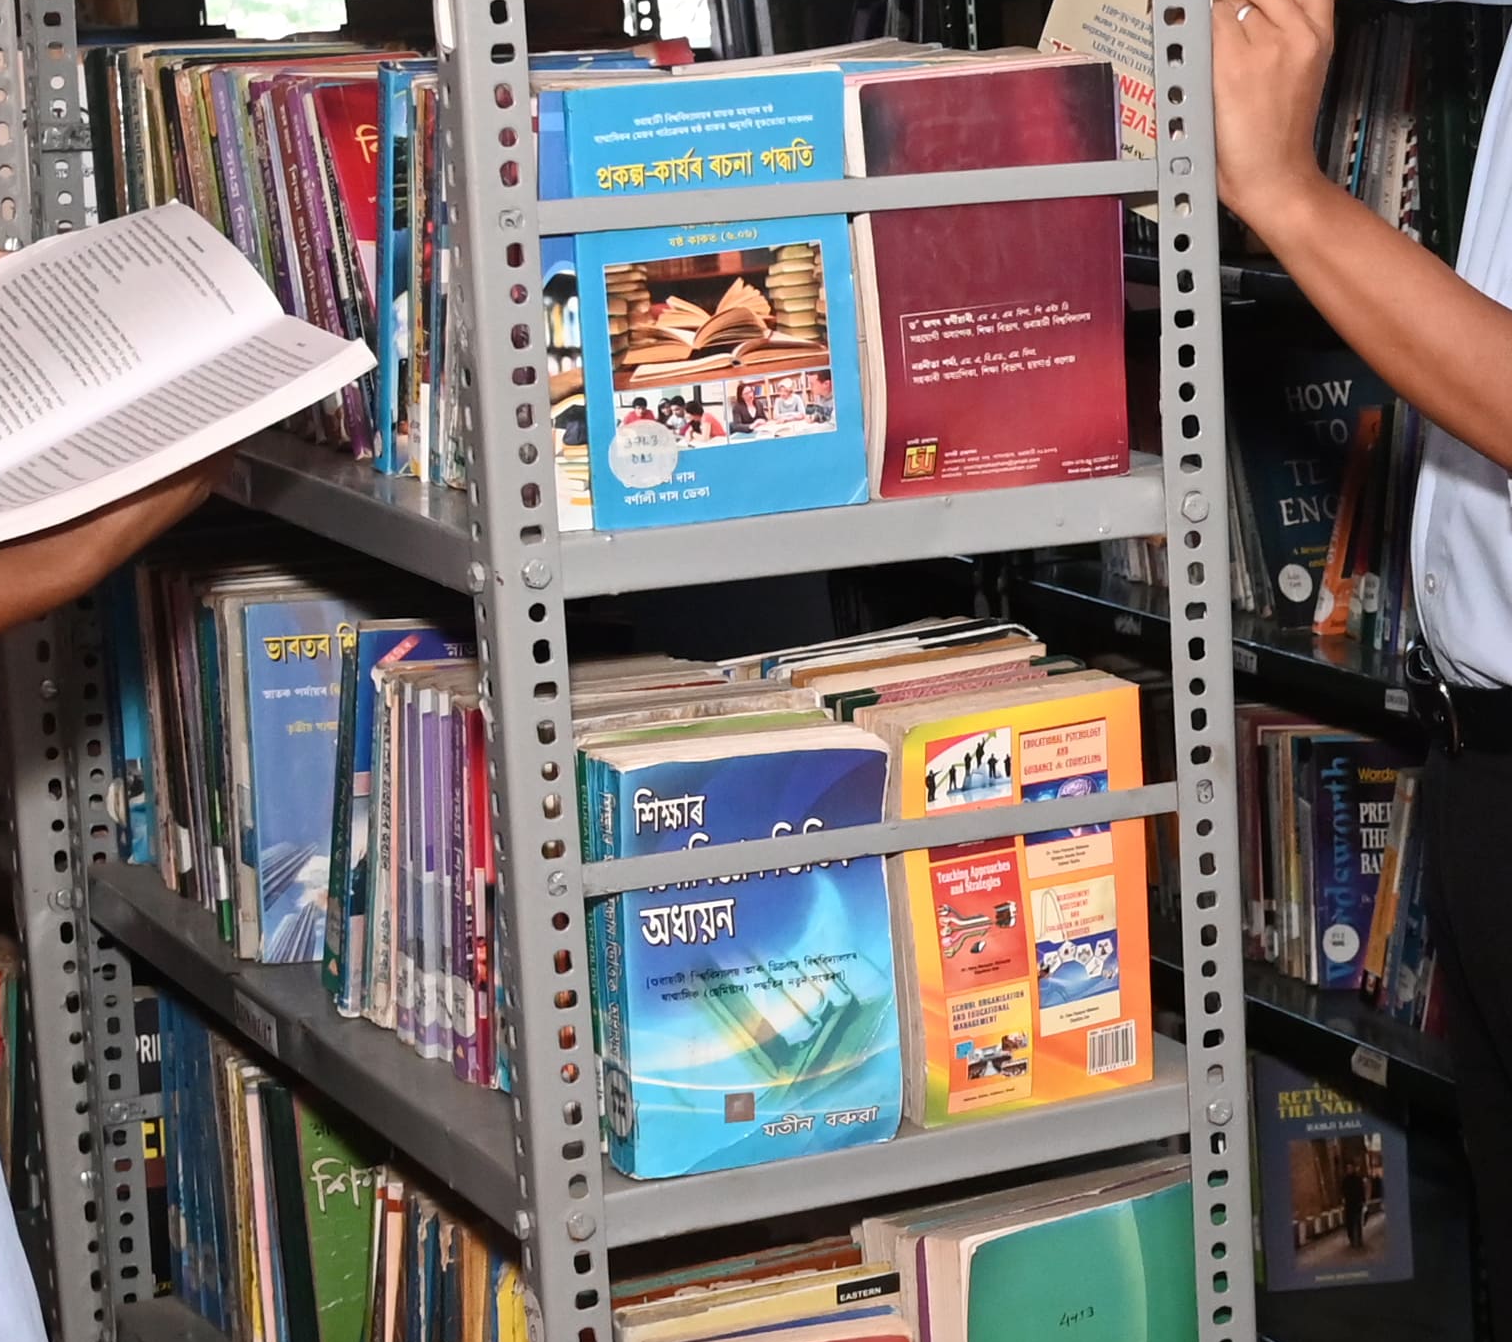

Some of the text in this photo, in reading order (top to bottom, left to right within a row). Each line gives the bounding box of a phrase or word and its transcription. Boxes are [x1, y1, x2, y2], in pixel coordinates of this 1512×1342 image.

[937, 860, 1011, 885] Teaching Approaches
[840, 1284, 882, 1302] EASTERN
